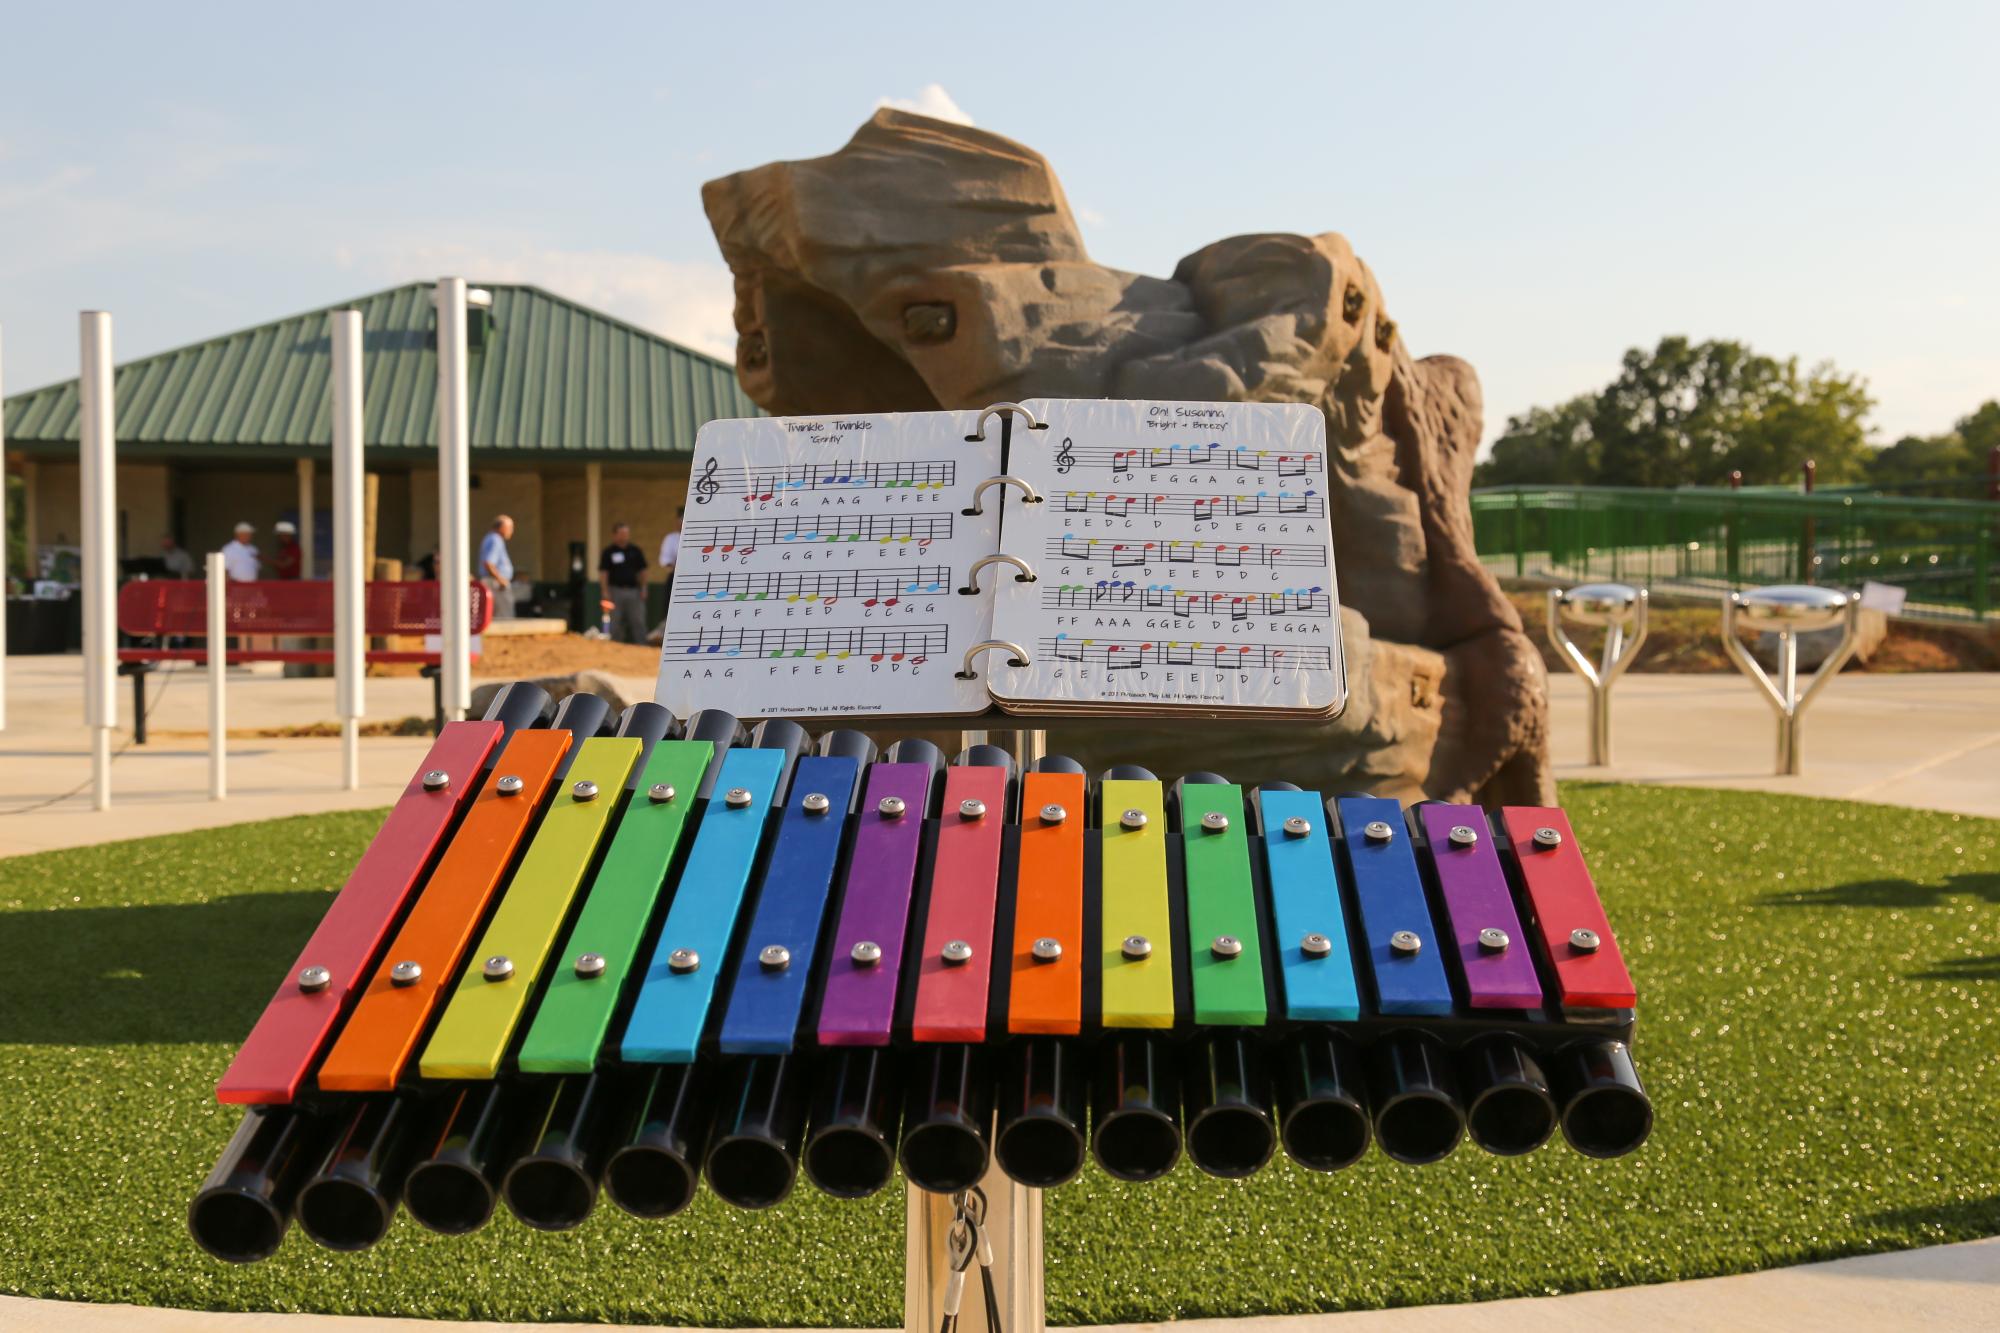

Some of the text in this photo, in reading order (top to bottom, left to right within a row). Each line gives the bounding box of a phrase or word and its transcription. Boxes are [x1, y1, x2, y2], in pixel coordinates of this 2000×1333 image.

[1149, 406, 1225, 418] Oh! Susanna
[784, 420, 872, 432] Twinkle Twinkle
[1113, 473, 1313, 488] C D E G G A G E C D
[744, 494, 939, 511] C C G G A A G F F E E
[1064, 518, 1314, 533] E E D C D C D E G G A
[702, 547, 927, 565] D D C G G F F E E D
[1061, 566, 1279, 581] G E C D E E D D C
[692, 603, 934, 620] G G F F E E D C C G G
[1057, 616, 1320, 633] F F A A A G G E C D C D E G G A
[683, 663, 919, 679] A A G F F E E D D C
[1054, 668, 1281, 685] G E C D E E D D C
